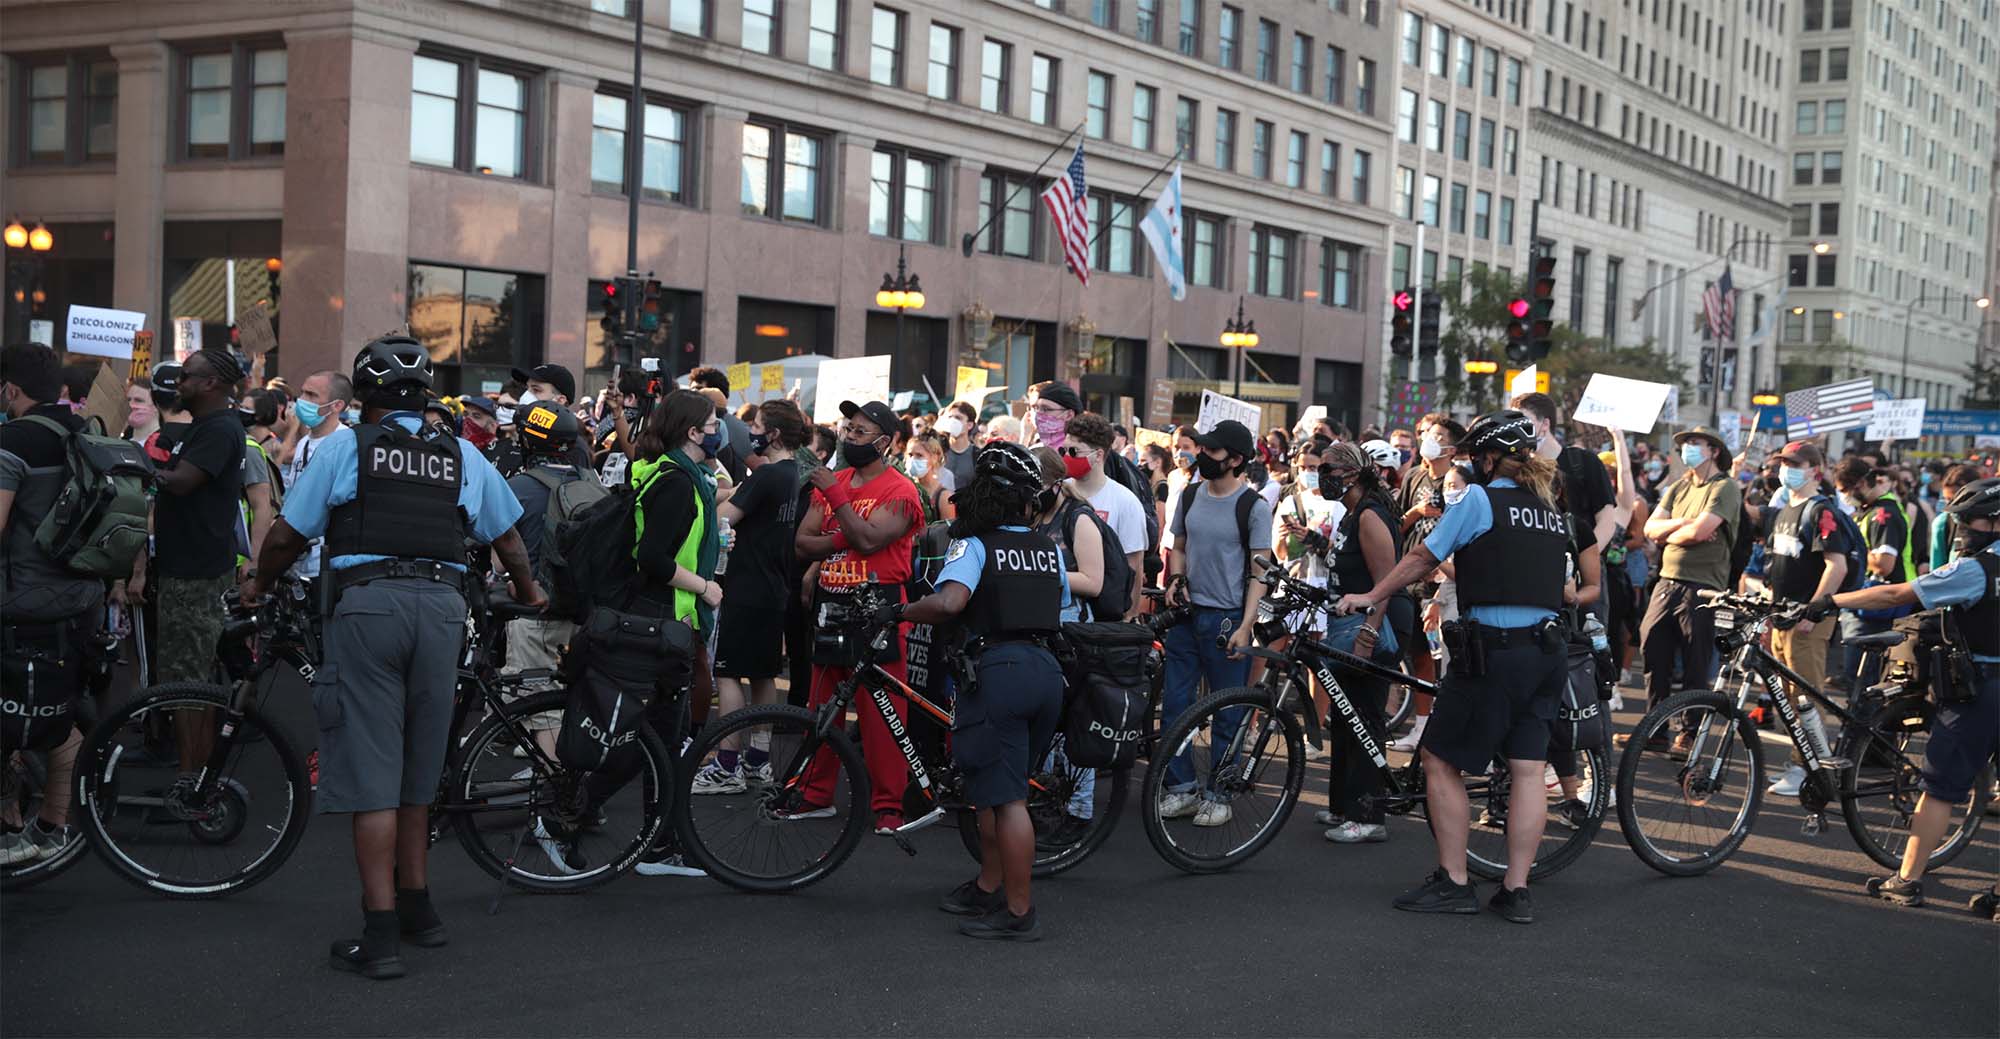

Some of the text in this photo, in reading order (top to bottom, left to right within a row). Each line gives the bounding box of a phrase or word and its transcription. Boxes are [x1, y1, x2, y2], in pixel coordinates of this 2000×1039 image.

[72, 316, 138, 332] DECOLONIZE
[531, 412, 551, 426] OUT
[1875, 408, 1918, 419] JUSTICE
[1876, 428, 1908, 438] PEACE
[372, 447, 455, 481] POLICE
[1508, 506, 1566, 535] POLICE
[995, 549, 1058, 573] POLICE
[0, 697, 67, 718] OLICE
[1317, 668, 1353, 717] CHICAGO
[1348, 715, 1380, 758] POLICE
[1559, 703, 1599, 721] OLICE
[1767, 673, 1815, 761] CHICAGO POLICE
[580, 716, 636, 748] POLICE
[872, 687, 926, 778] CHICAGO POLICE
